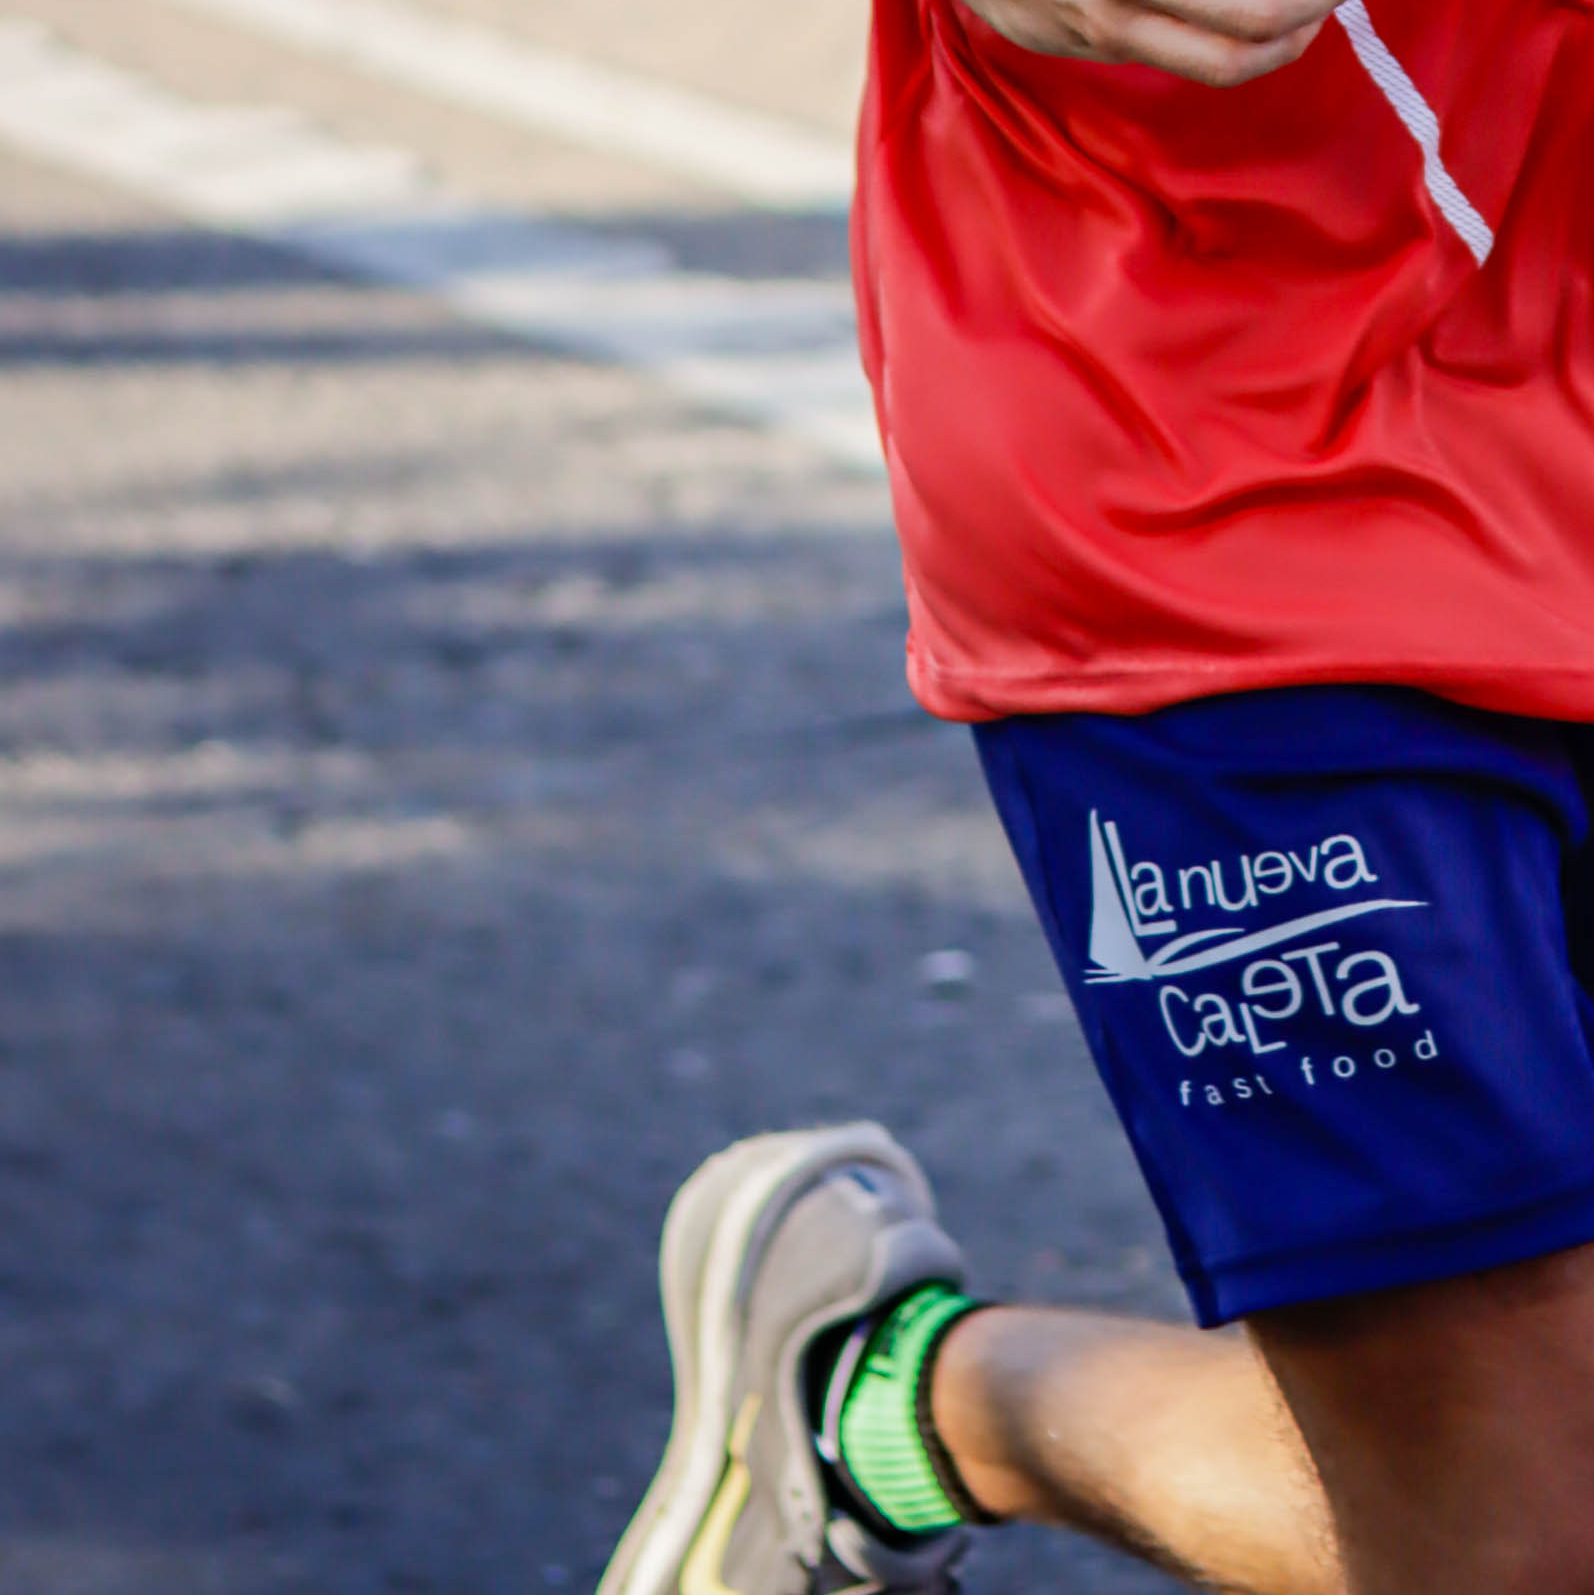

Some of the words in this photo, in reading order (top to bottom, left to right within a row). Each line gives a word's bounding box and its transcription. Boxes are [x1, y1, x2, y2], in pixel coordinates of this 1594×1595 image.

[1179, 833, 1379, 912] nueva
[1178, 1074, 1273, 1107] fast
[1300, 1029, 1438, 1086] food
